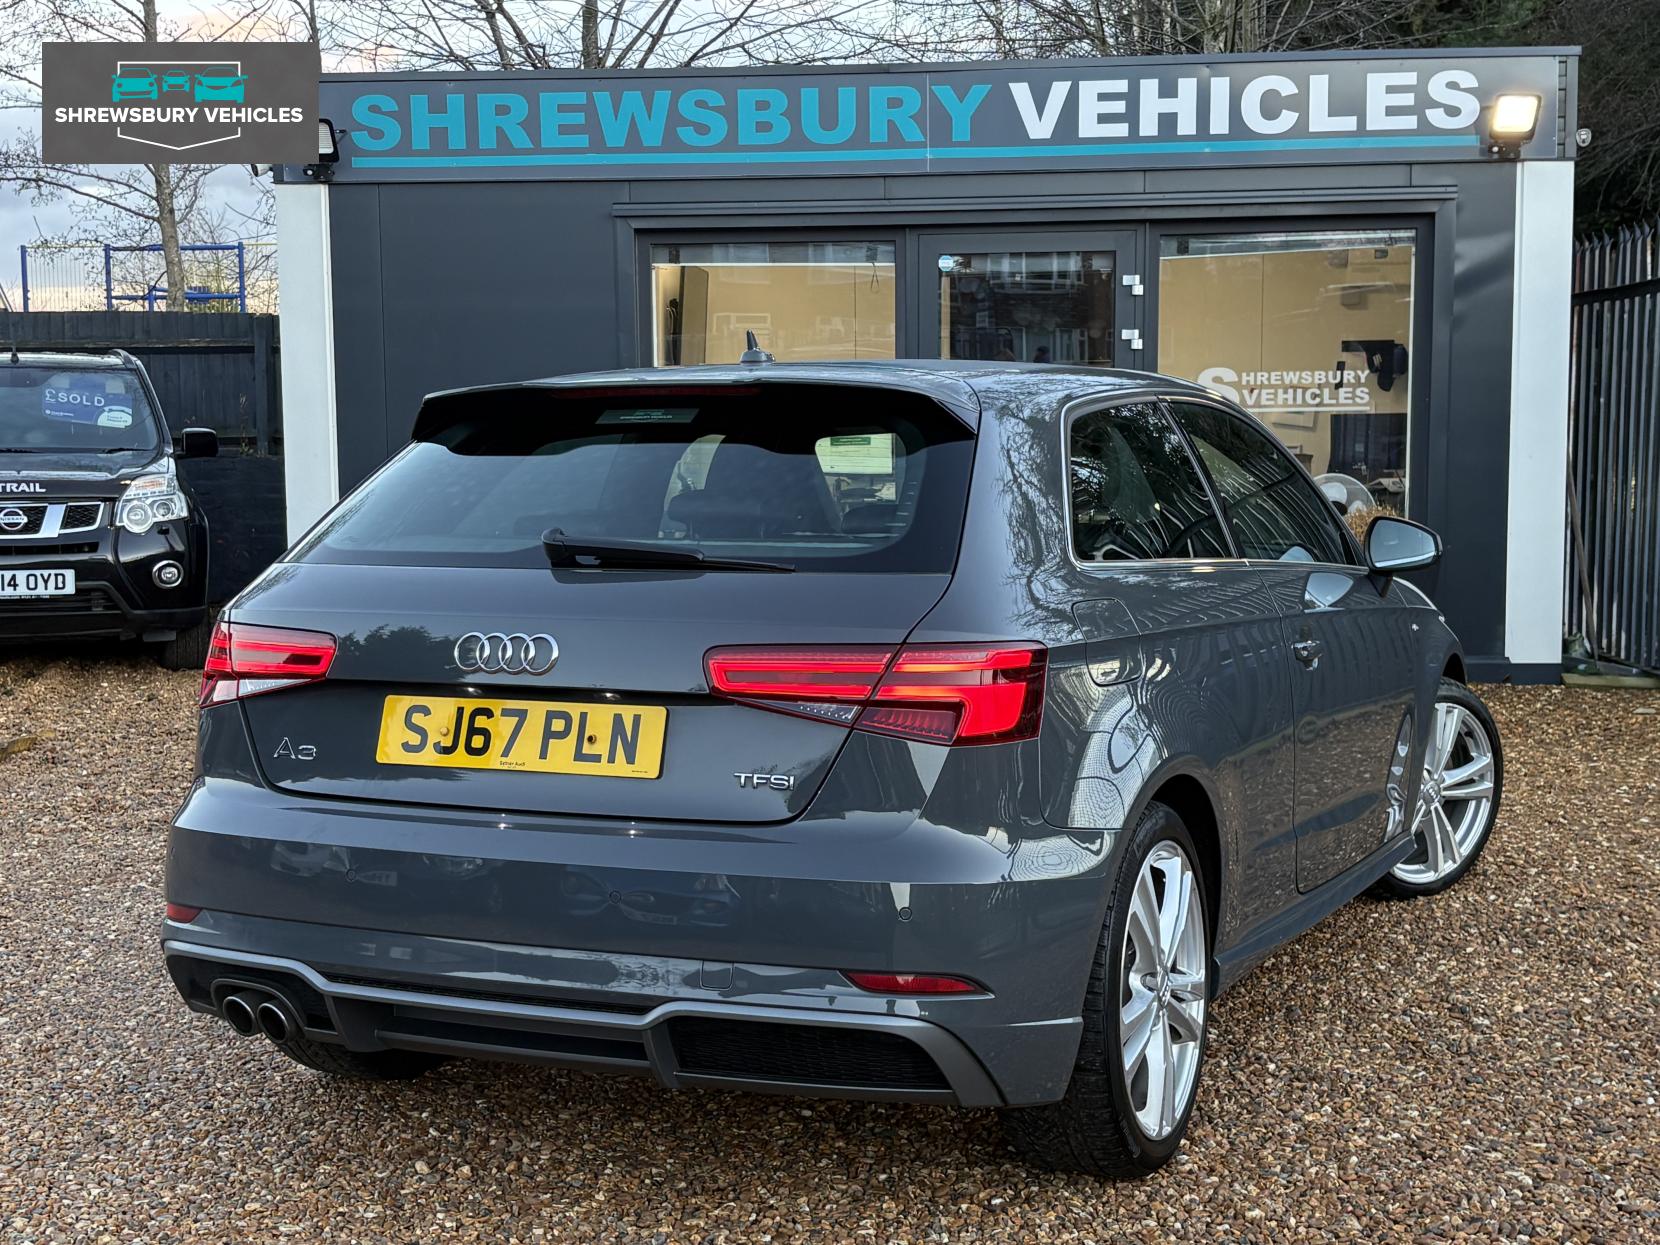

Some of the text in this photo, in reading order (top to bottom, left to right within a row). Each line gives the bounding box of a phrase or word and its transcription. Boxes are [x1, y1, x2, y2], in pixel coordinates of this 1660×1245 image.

[350, 70, 1480, 151] SHREWSBURY VEHICLES
[1198, 367, 1370, 404] SHREWSBURY
[1242, 387, 1370, 405] VEHICLES
[0, 573, 66, 591] 14 OYD
[400, 705, 641, 765] SJ67 PLN
[273, 738, 317, 761] A3
[733, 771, 796, 791] TFSI
